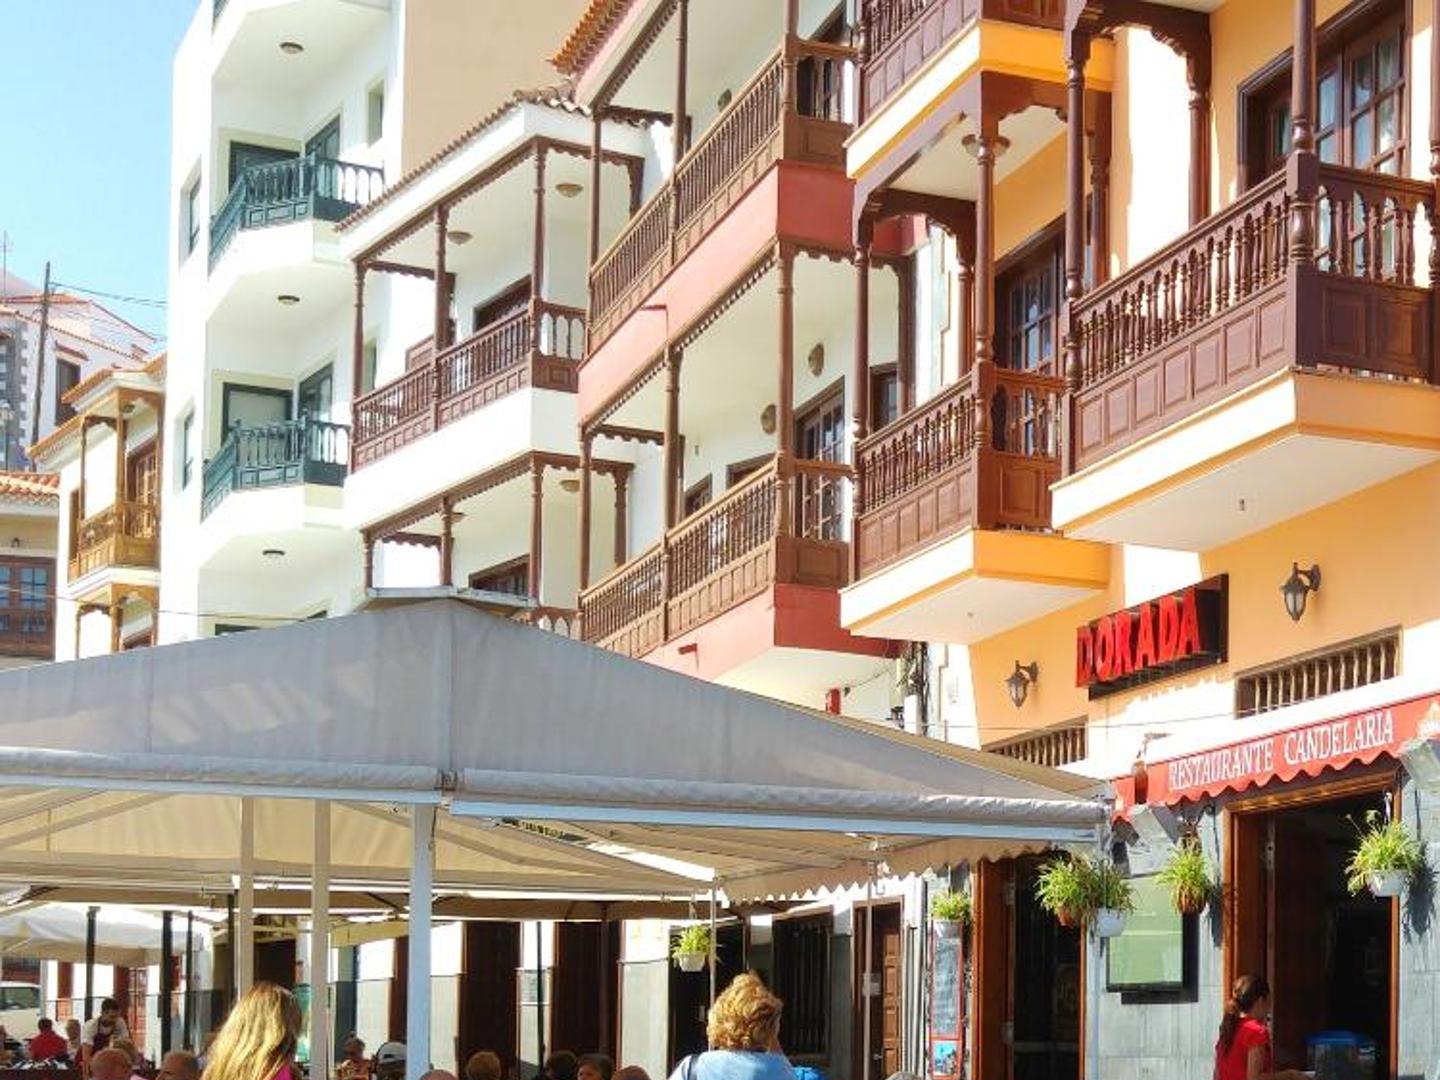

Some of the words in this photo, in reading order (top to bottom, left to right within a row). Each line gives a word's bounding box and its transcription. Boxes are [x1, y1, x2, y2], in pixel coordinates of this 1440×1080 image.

[1075, 586, 1201, 688] DORADA
[1168, 738, 1275, 792] RESTAURANTE
[1283, 711, 1395, 766] CANDELARIA
